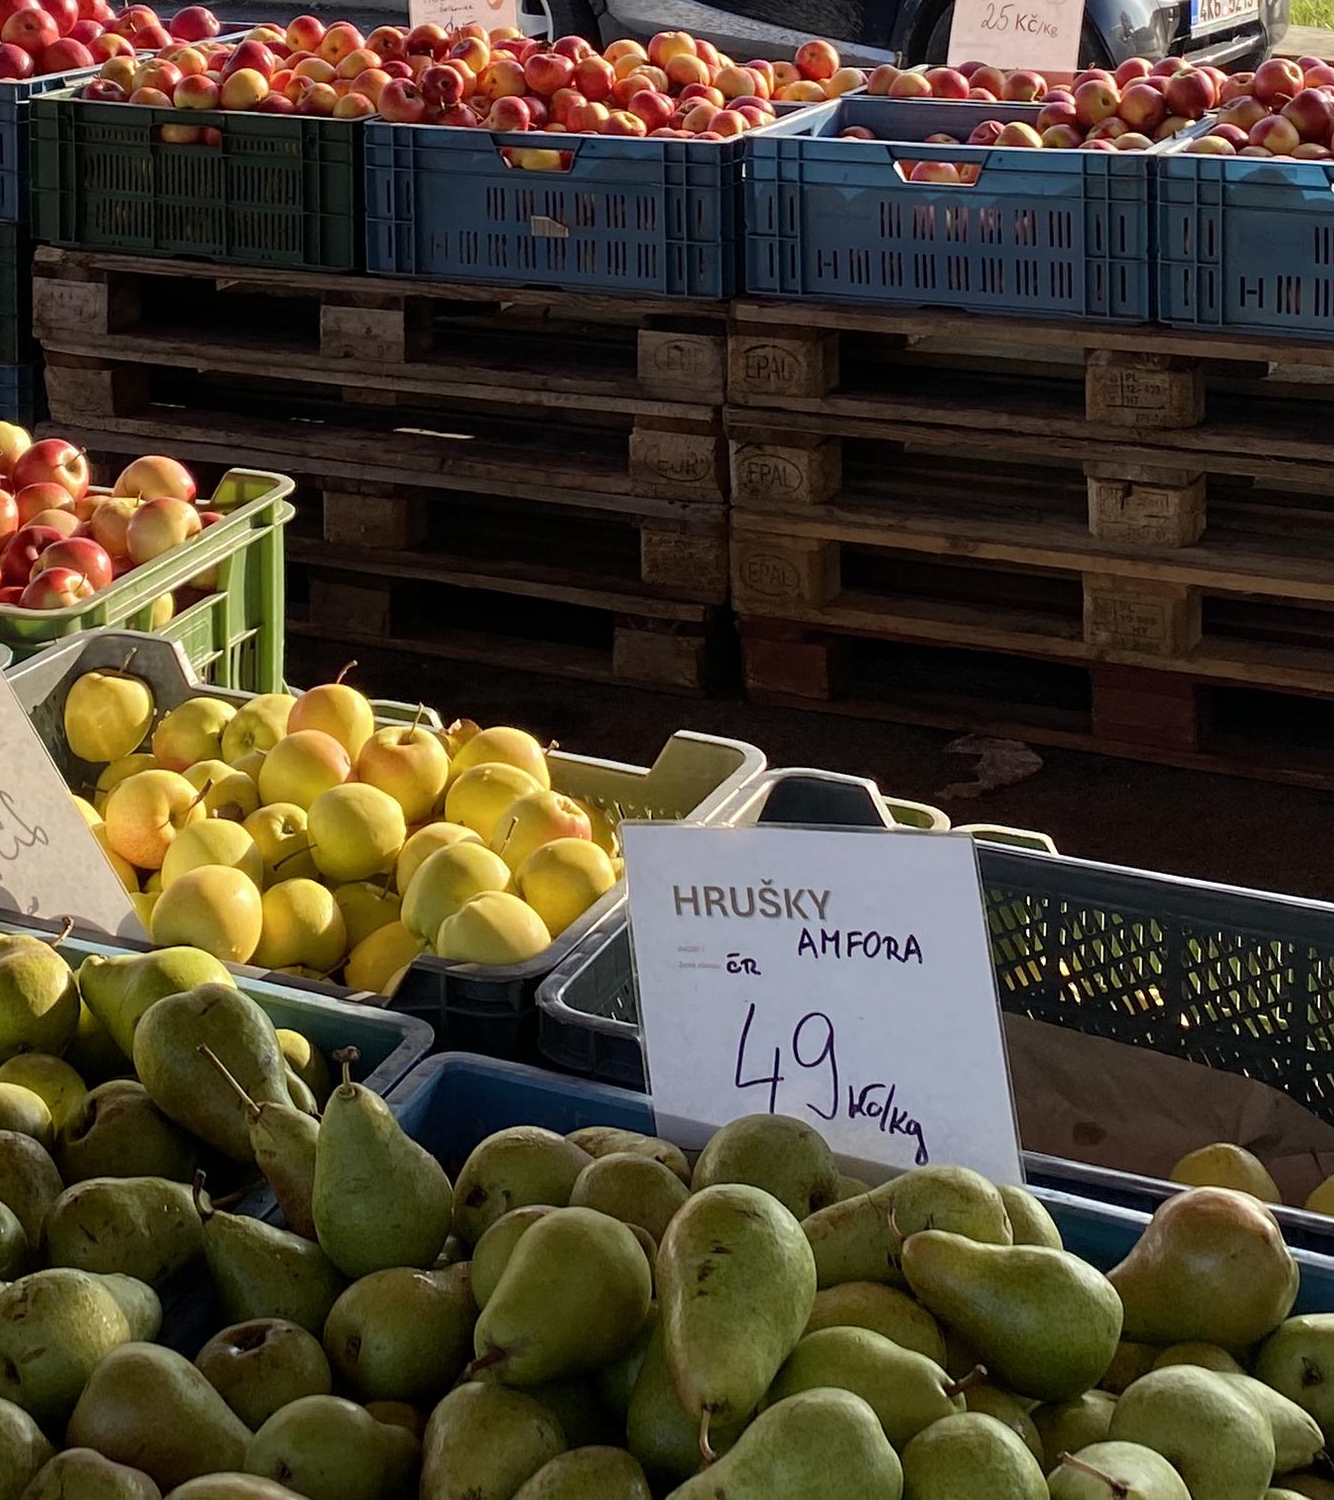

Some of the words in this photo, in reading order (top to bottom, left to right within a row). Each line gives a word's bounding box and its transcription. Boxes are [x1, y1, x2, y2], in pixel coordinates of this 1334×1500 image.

[980, 3, 1015, 31] 25
[746, 462, 792, 488] EPAL
[672, 878, 832, 921] HRUŠKY
[798, 927, 923, 965] AMFORA
[726, 952, 762, 976] ČR
[735, 1003, 838, 1120] 49
